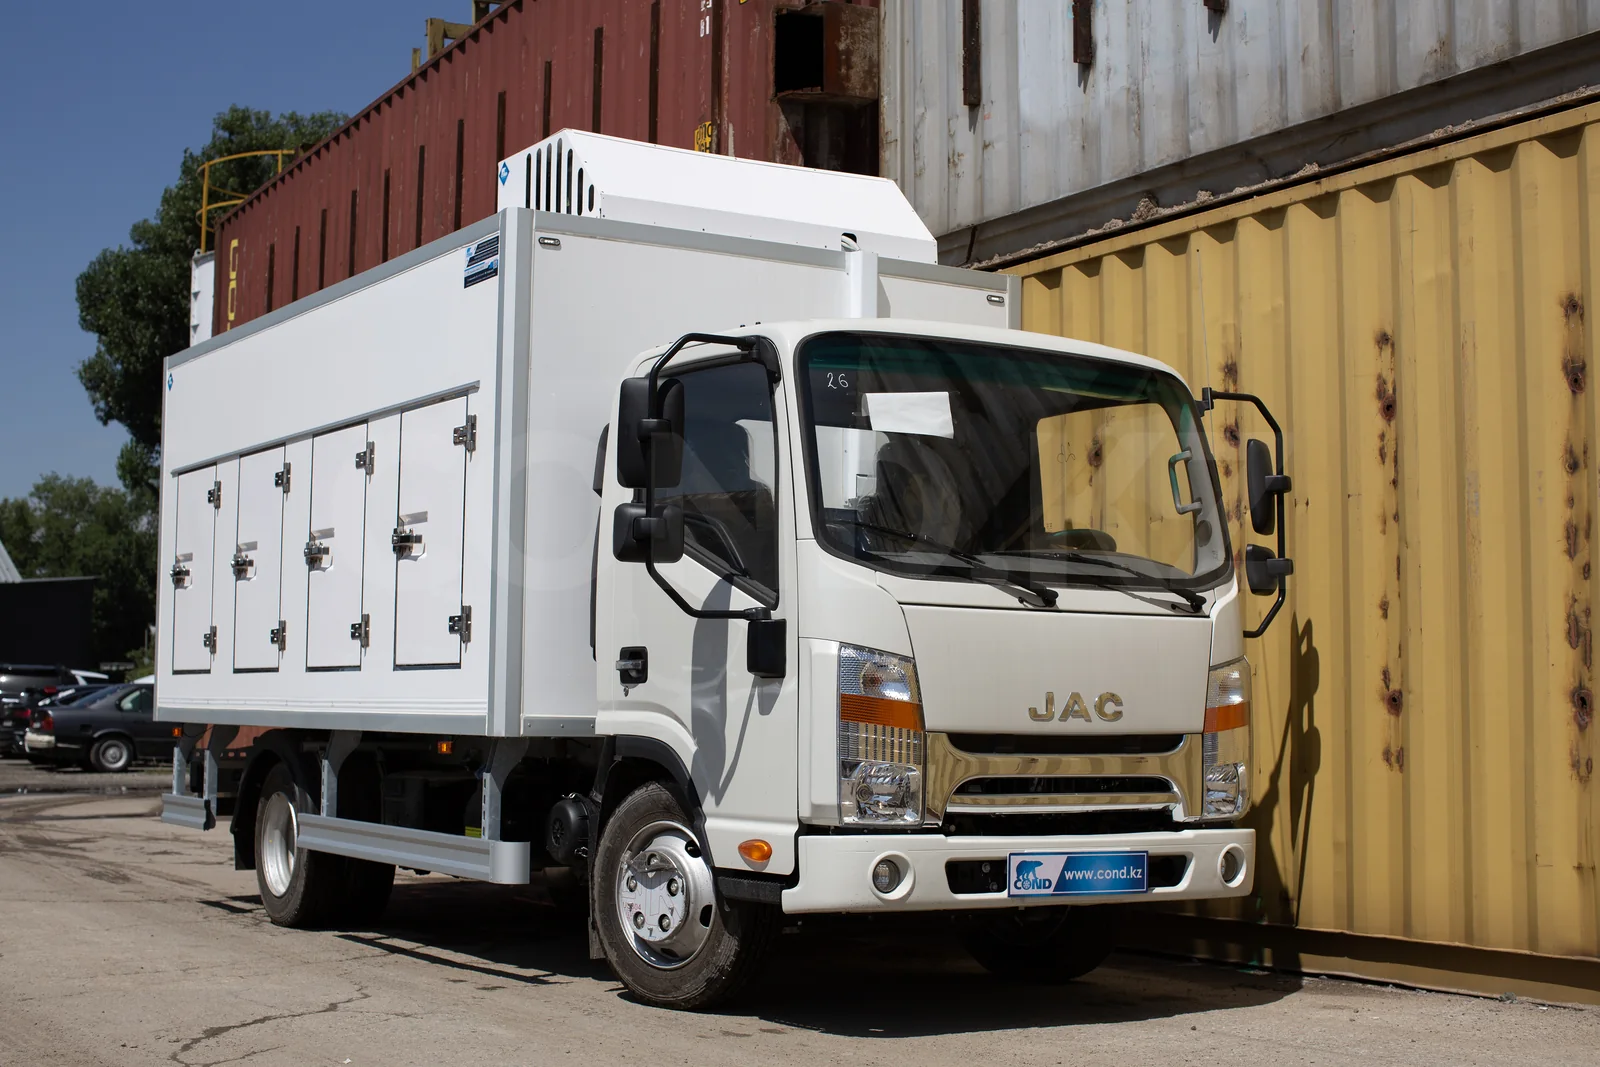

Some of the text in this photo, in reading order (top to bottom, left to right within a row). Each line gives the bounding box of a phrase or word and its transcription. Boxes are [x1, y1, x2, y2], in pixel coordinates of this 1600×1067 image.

[826, 372, 849, 389] 26
[1028, 691, 1124, 722] JAC
[1064, 865, 1142, 881] www.cond.kz
[1013, 878, 1053, 891] COND
